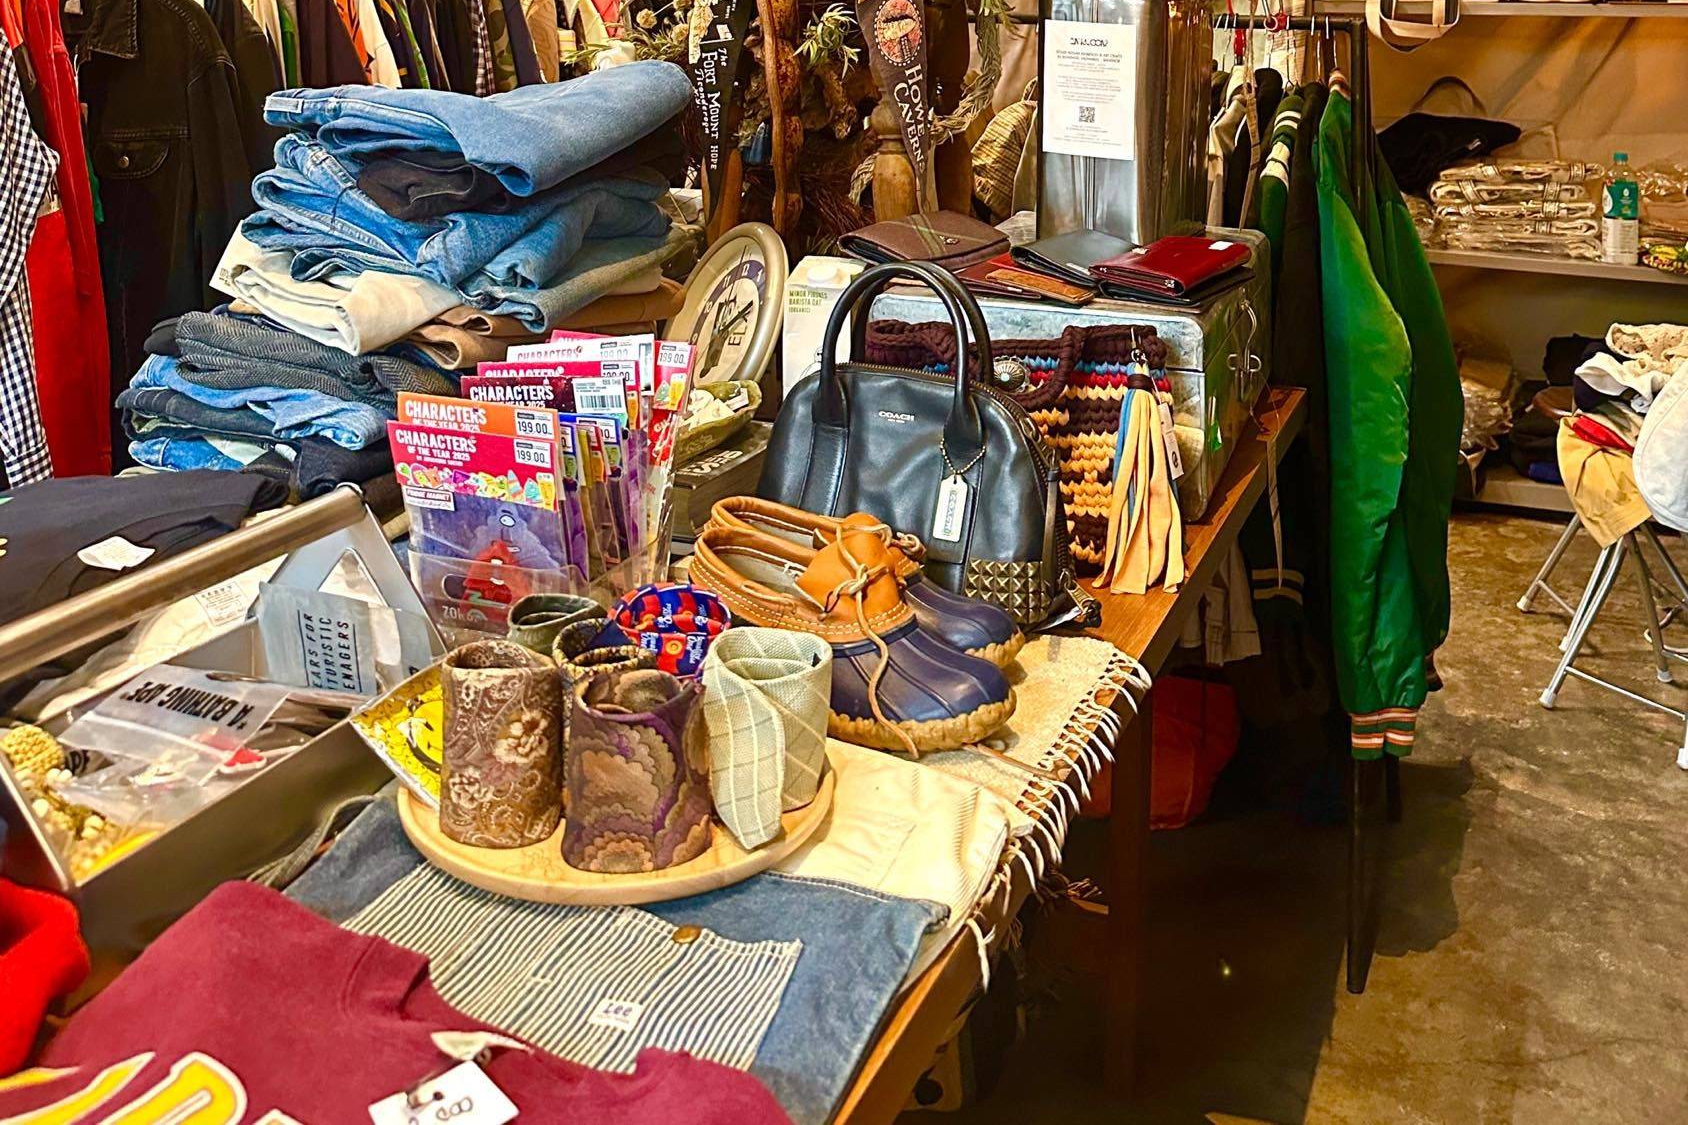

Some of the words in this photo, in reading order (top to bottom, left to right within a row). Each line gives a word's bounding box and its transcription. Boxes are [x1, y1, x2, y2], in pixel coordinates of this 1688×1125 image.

[702, 51, 718, 86] FORT
[718, 47, 728, 67] The
[905, 63, 925, 137] HOWE
[707, 91, 721, 139] MOUNT
[894, 82, 925, 174] CAVERNS
[710, 145, 718, 170] HOPE
[470, 385, 554, 401] CHARACTERS
[405, 400, 487, 425] CHARACTERS
[878, 410, 915, 422] COACH
[395, 429, 477, 453] CHARACTERS
[304, 613, 316, 642] FOR
[157, 686, 239, 722] BATHING
[603, 1003, 632, 1016] Lee
